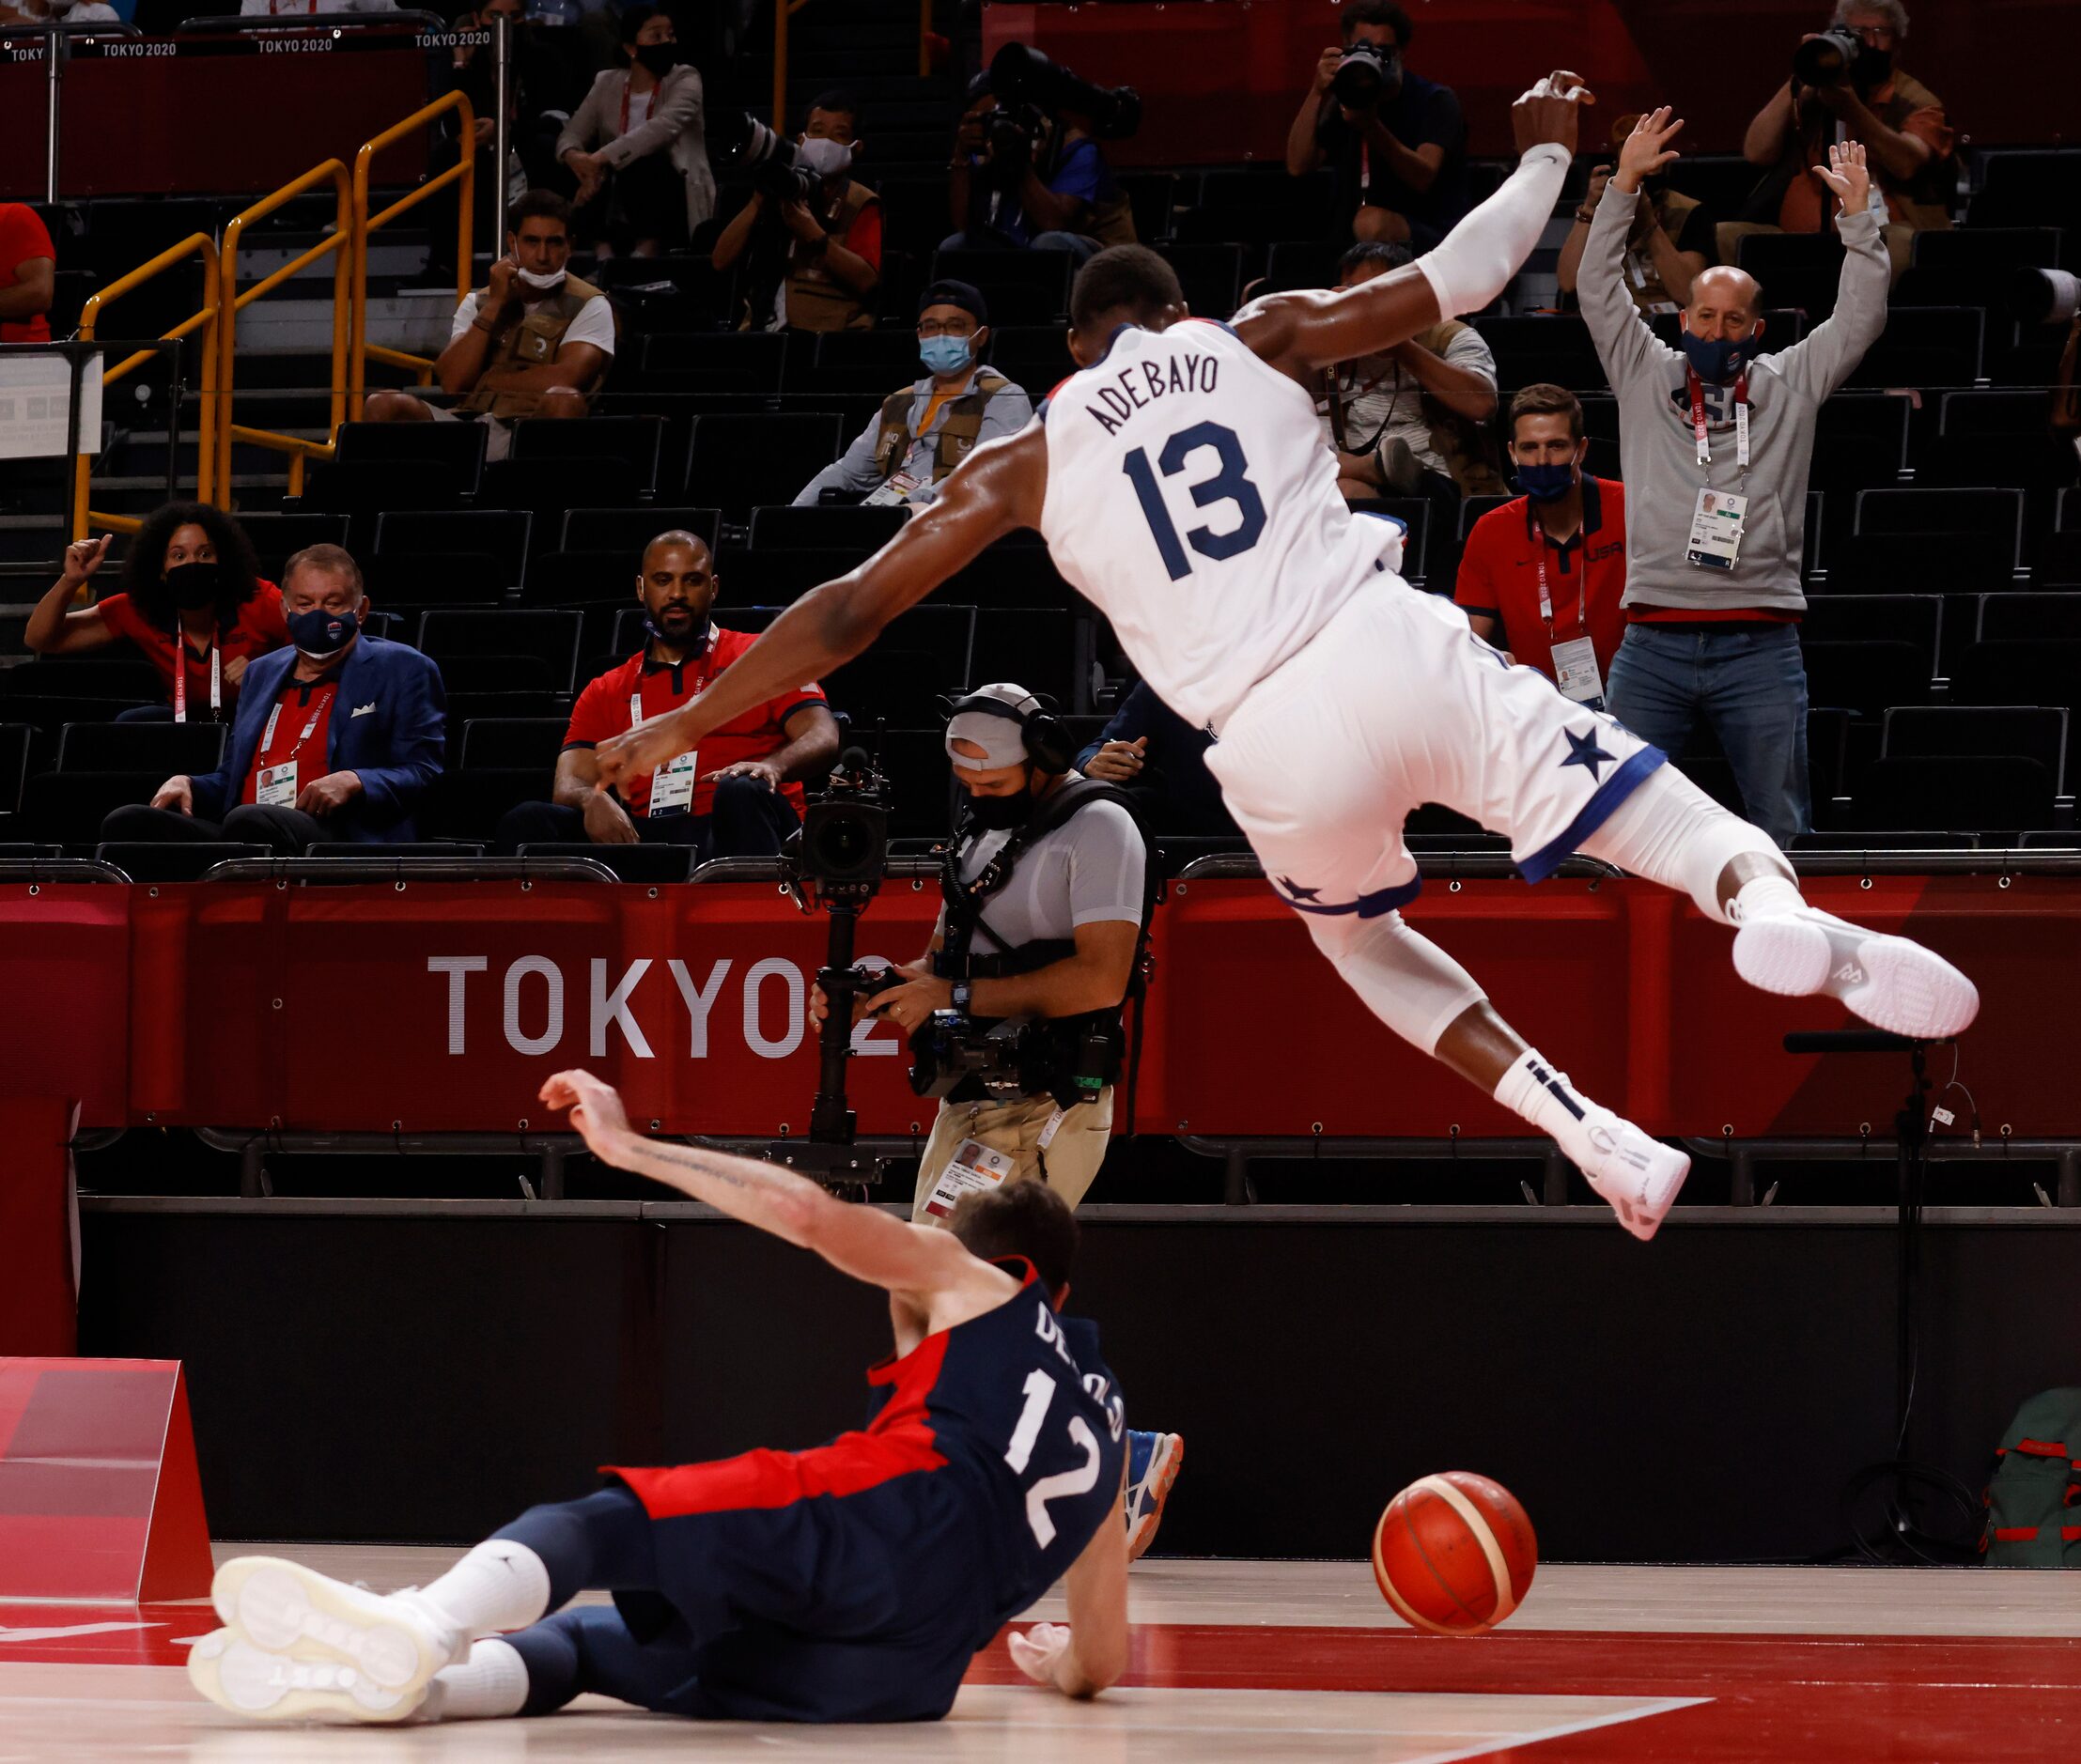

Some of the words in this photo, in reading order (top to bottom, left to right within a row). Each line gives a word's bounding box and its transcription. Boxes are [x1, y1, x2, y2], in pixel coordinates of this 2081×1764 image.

[103, 44, 143, 57] TOKYO
[146, 43, 177, 56] 2020
[258, 39, 299, 54] TOKYO
[302, 39, 333, 52] 2020
[415, 34, 457, 47] TOKYO
[458, 32, 490, 45] 2020
[11, 48, 43, 61] TOKY
[1085, 354, 1219, 436] ADEBAYO
[1695, 402, 1703, 423] TOKYO
[1123, 420, 1268, 582] 13
[1585, 541, 1623, 563] USA
[1538, 562, 1546, 582] TOKYO
[427, 954, 804, 1059] TOKYO
[851, 955, 899, 1057] 2
[1003, 1368, 1101, 1550] 12
